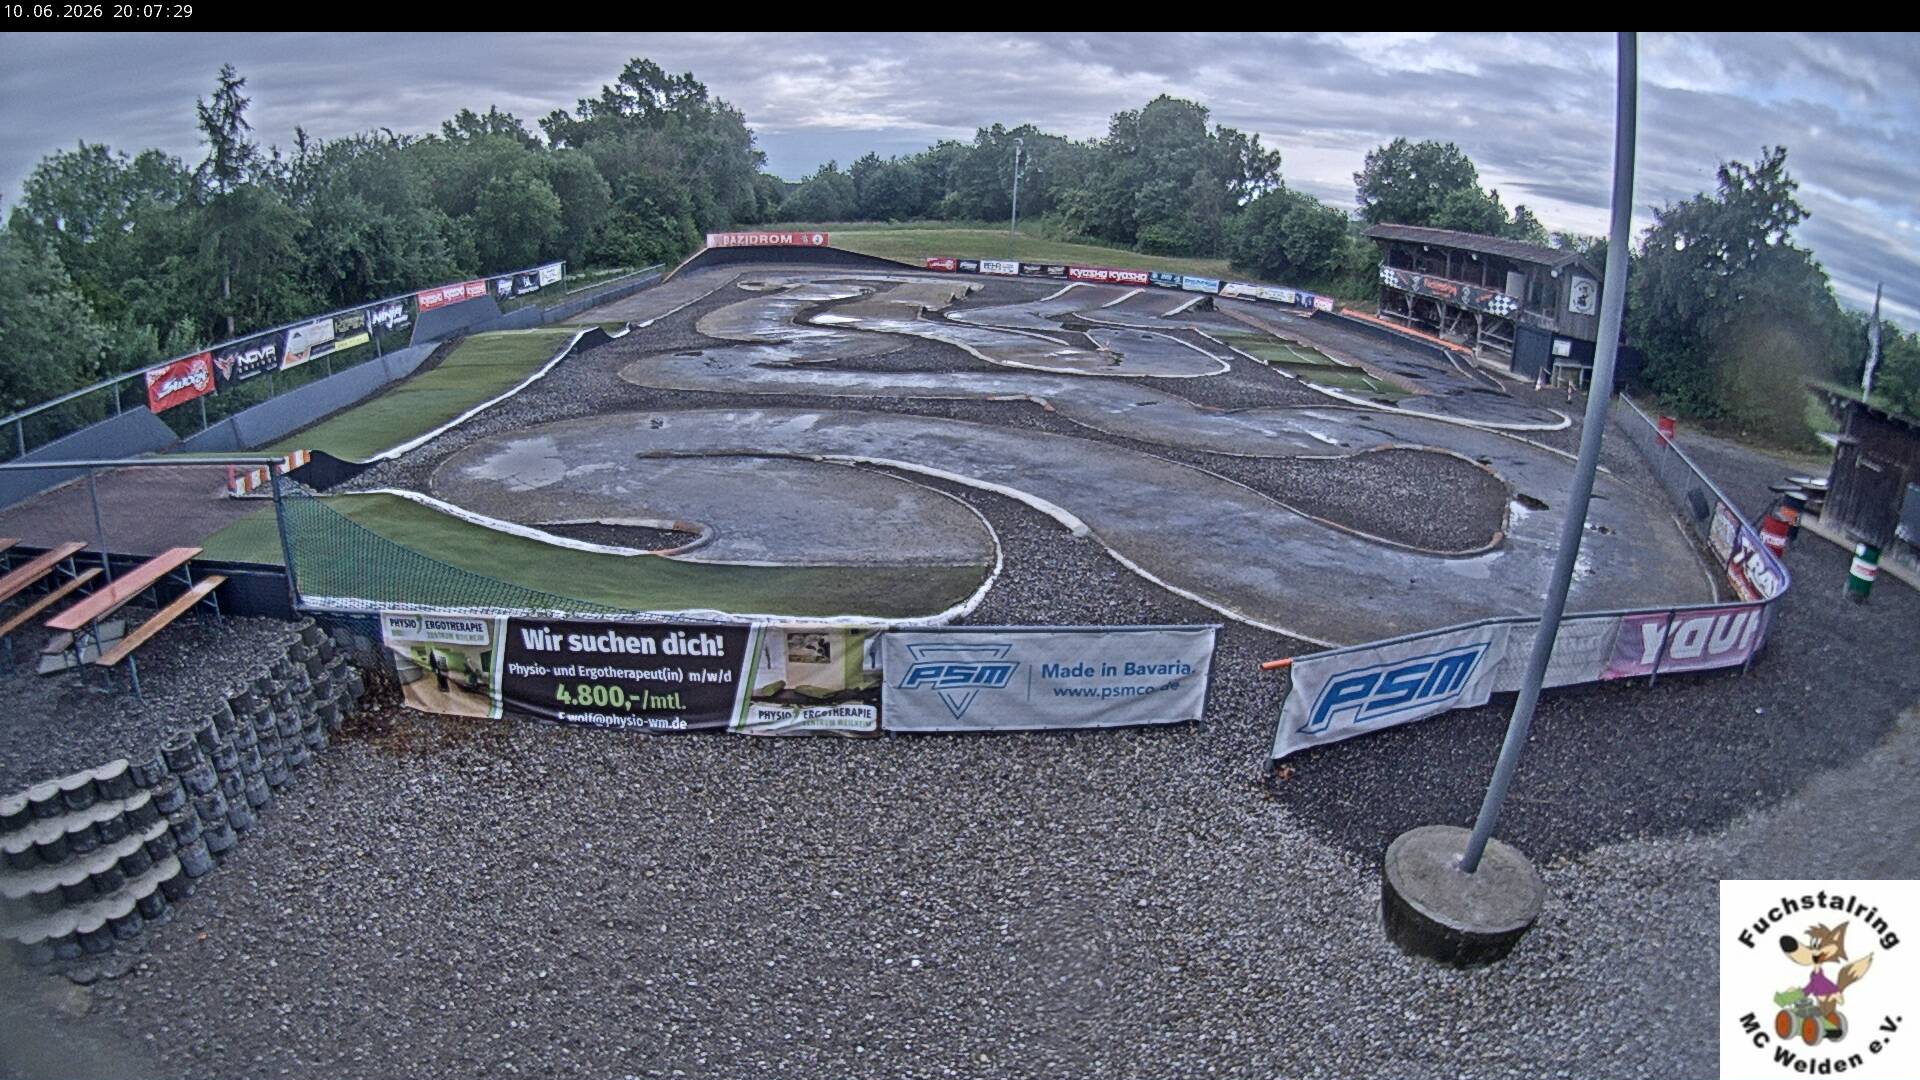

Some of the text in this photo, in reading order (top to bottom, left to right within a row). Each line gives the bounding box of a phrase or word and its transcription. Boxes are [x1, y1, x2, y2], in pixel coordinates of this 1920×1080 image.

[390, 618, 483, 633] PHYSIO ERGOTHERAPIE
[521, 626, 725, 657] Wir suchen dich!
[508, 663, 732, 683] Physio- und Ergotherapeut(in) m/w/d
[905, 663, 1013, 687] PSM
[1041, 662, 1095, 679] Made
[1101, 662, 1117, 677] in
[1307, 648, 1484, 729] PSM
[758, 710, 792, 721] PHYSIO
